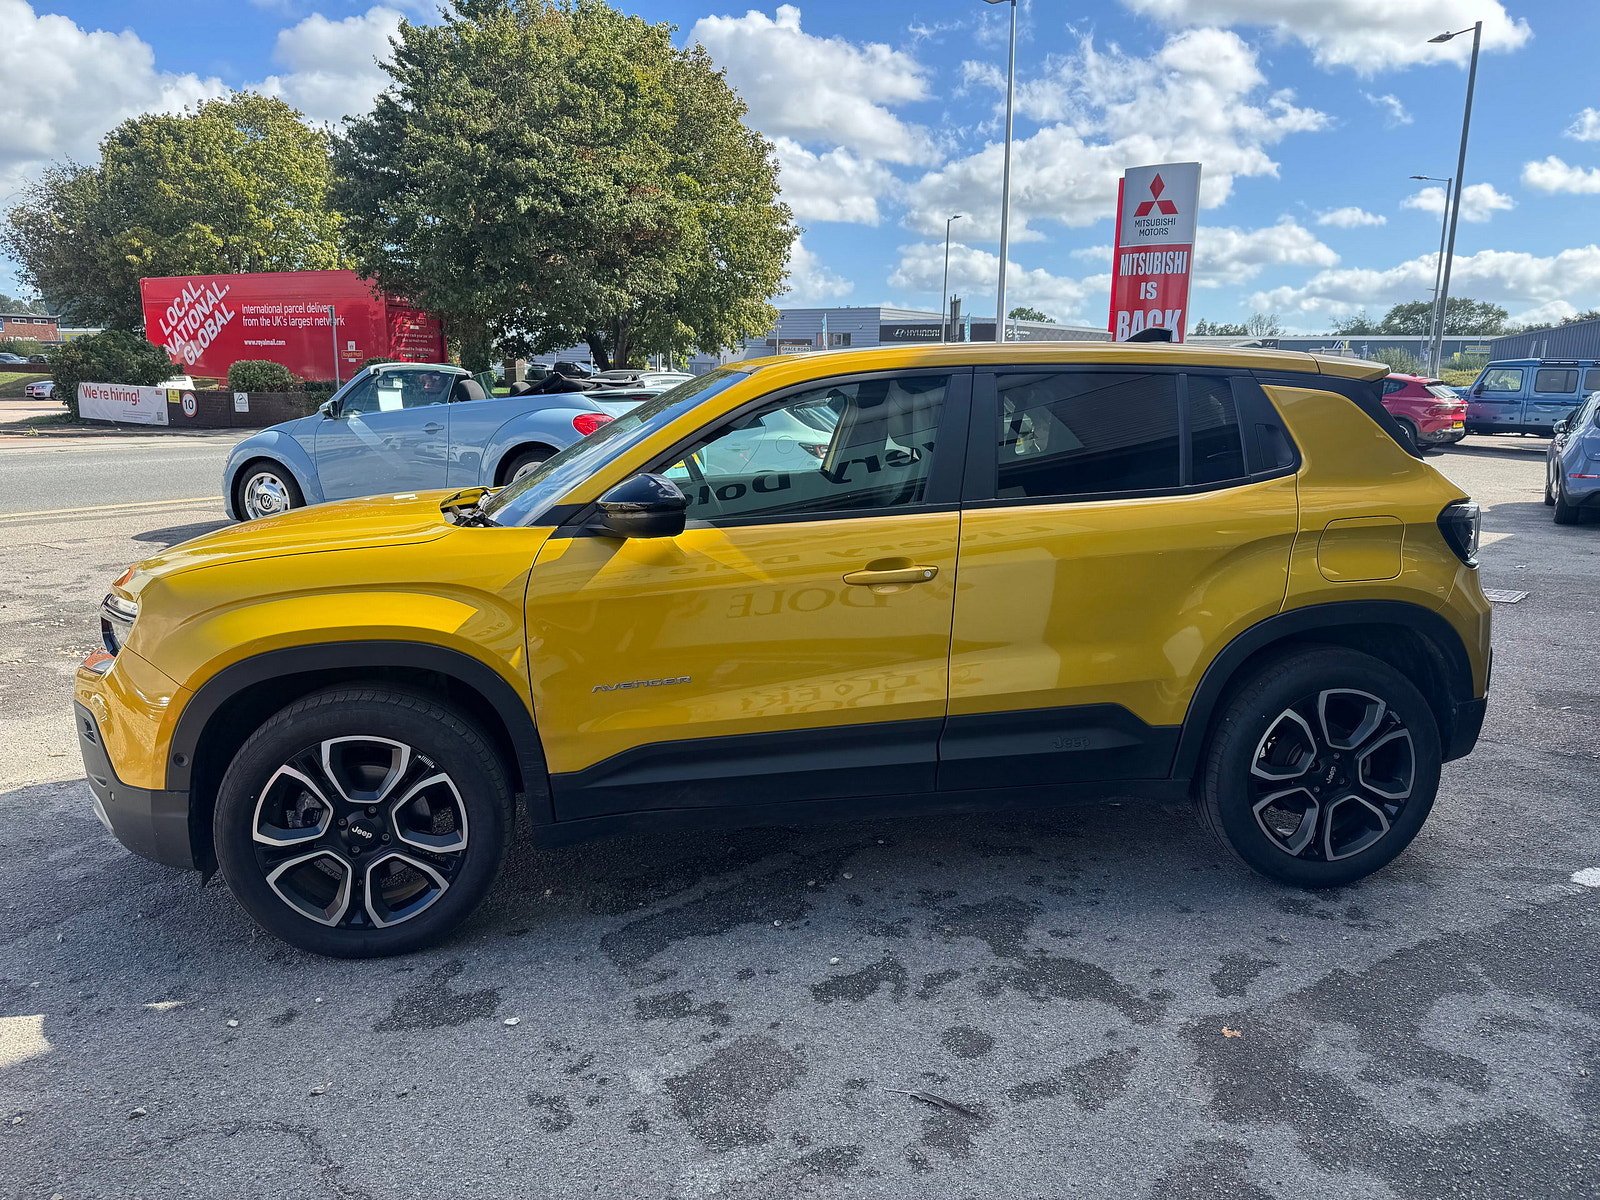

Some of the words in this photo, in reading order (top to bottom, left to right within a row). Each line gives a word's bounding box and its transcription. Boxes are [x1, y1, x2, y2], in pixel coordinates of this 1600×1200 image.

[1134, 217, 1176, 228] MITSUBISHI
[1138, 227, 1169, 237] MOTORS
[1119, 251, 1188, 277] MITSUBISHI
[1139, 281, 1158, 300] IS
[159, 281, 205, 337] LOCAL.
[241, 303, 283, 314] International
[283, 302, 306, 316] parcel
[163, 281, 230, 361] NATIONAL.
[242, 315, 259, 327] from
[260, 315, 271, 327] the
[271, 315, 288, 327] UK's
[288, 315, 314, 329] largest
[183, 302, 236, 366] GLOBAL
[906, 329, 940, 337] HYUNDAI
[82, 385, 109, 400] We're
[109, 386, 140, 406] hiring!
[184, 399, 194, 410] 10
[591, 675, 692, 694] AVENGER
[1051, 735, 1091, 751] Jeep
[1325, 765, 1337, 784] Jeep
[351, 826, 373, 839] Jeep
